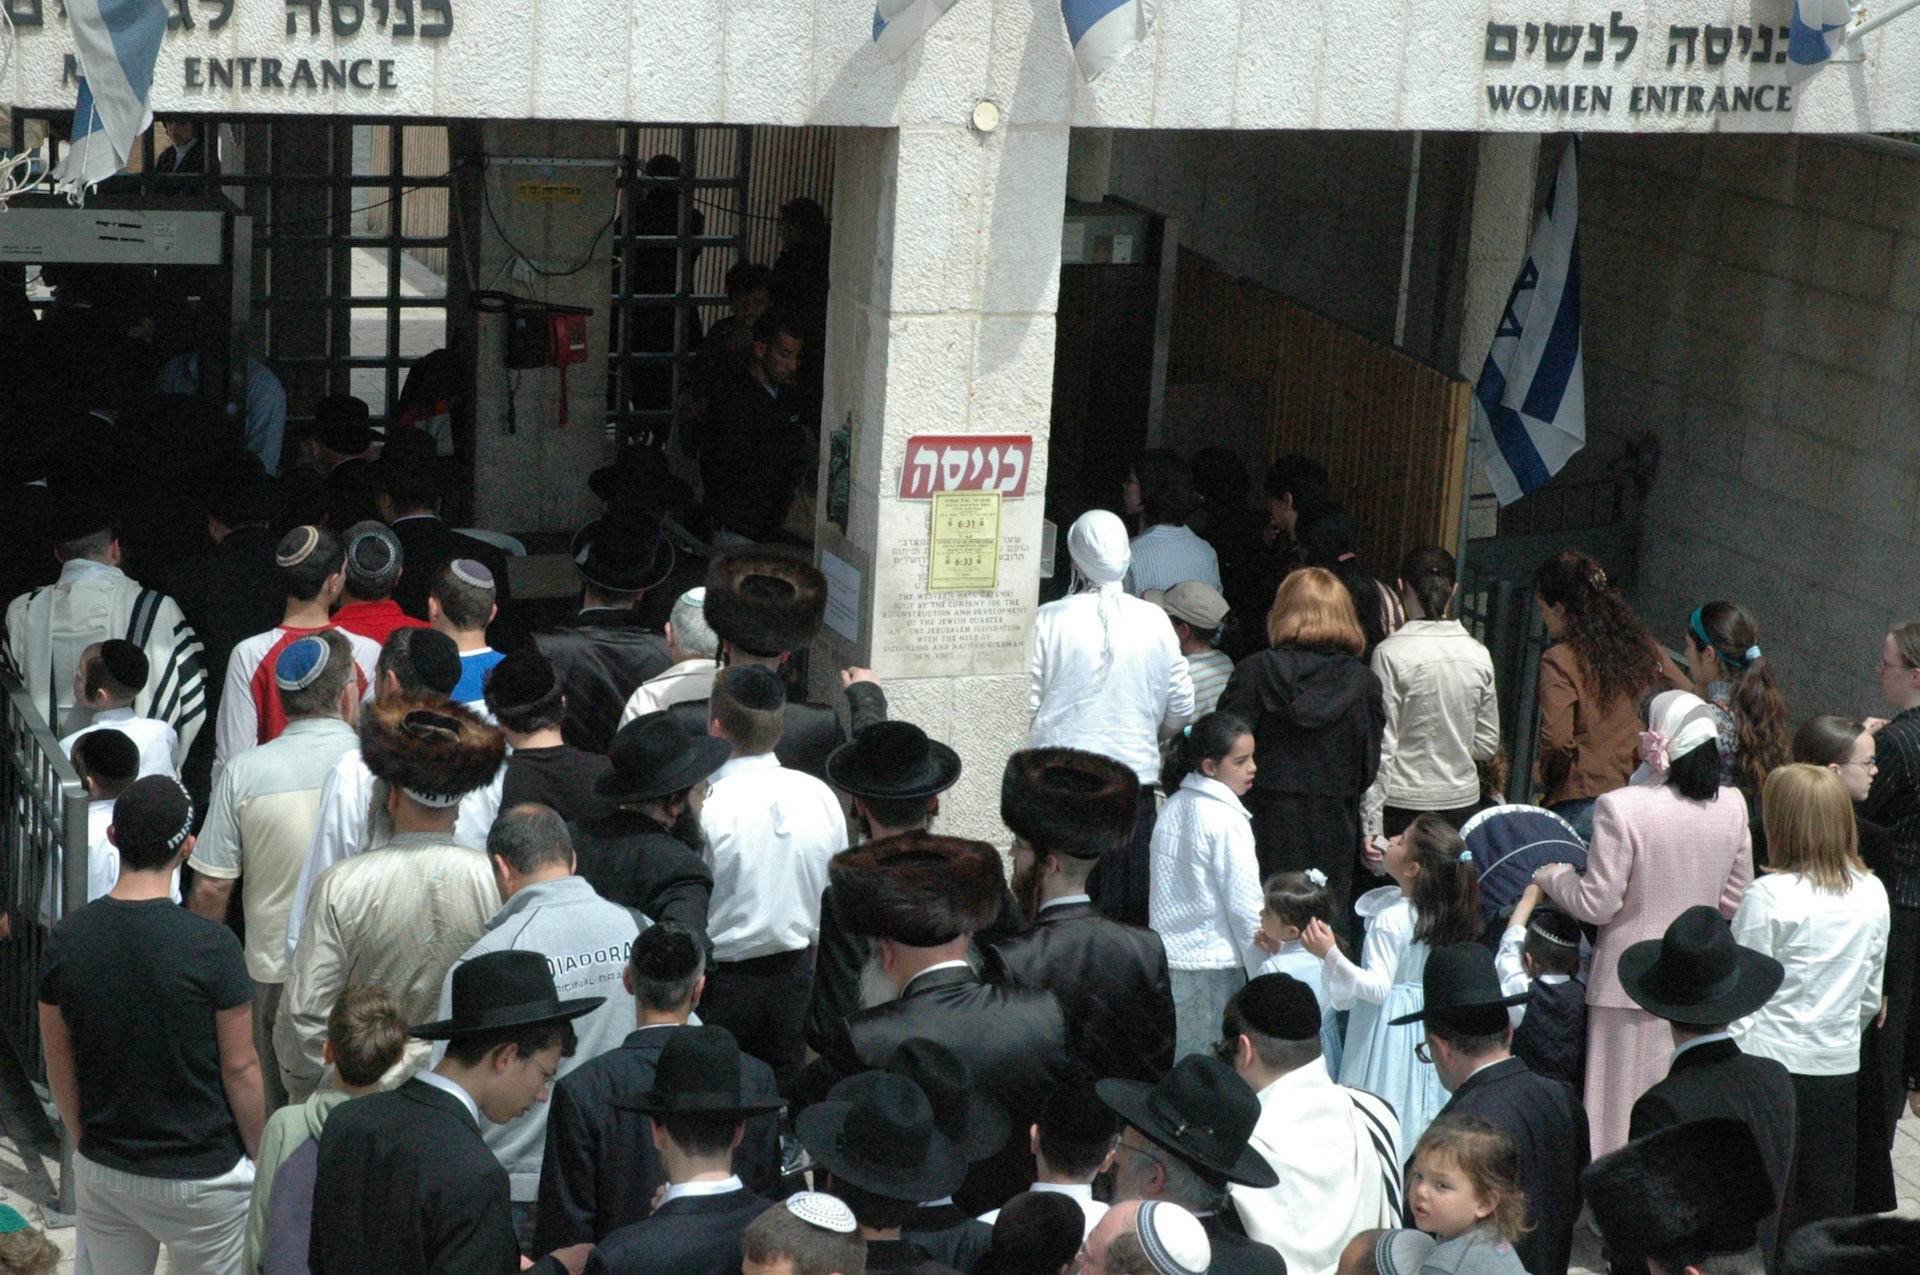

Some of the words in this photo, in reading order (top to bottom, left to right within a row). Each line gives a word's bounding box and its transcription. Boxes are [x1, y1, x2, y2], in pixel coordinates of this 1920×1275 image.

[287, 0, 452, 37] כניסה
[1485, 11, 1638, 63] לנשים
[185, 56, 399, 89] ENTRANCE
[1487, 84, 1613, 113] WOMEN
[1628, 84, 1793, 114] ENTRANCE
[910, 444, 1025, 495] כניסה
[957, 519, 976, 528] 6:31
[954, 557, 974, 567] 6:33
[931, 601, 946, 609] THE
[948, 599, 986, 608] COMPANY
[1004, 598, 1020, 606] THE
[953, 608, 971, 616] AND
[973, 607, 1028, 616] DEVELOPMENT
[919, 618, 935, 626] THE
[969, 616, 1003, 624] QUARTER
[927, 626, 971, 635] JERUSALEM
[917, 636, 938, 644] WITH
[556, 978, 595, 992] RIGINAL
[598, 972, 624, 983] BRA
